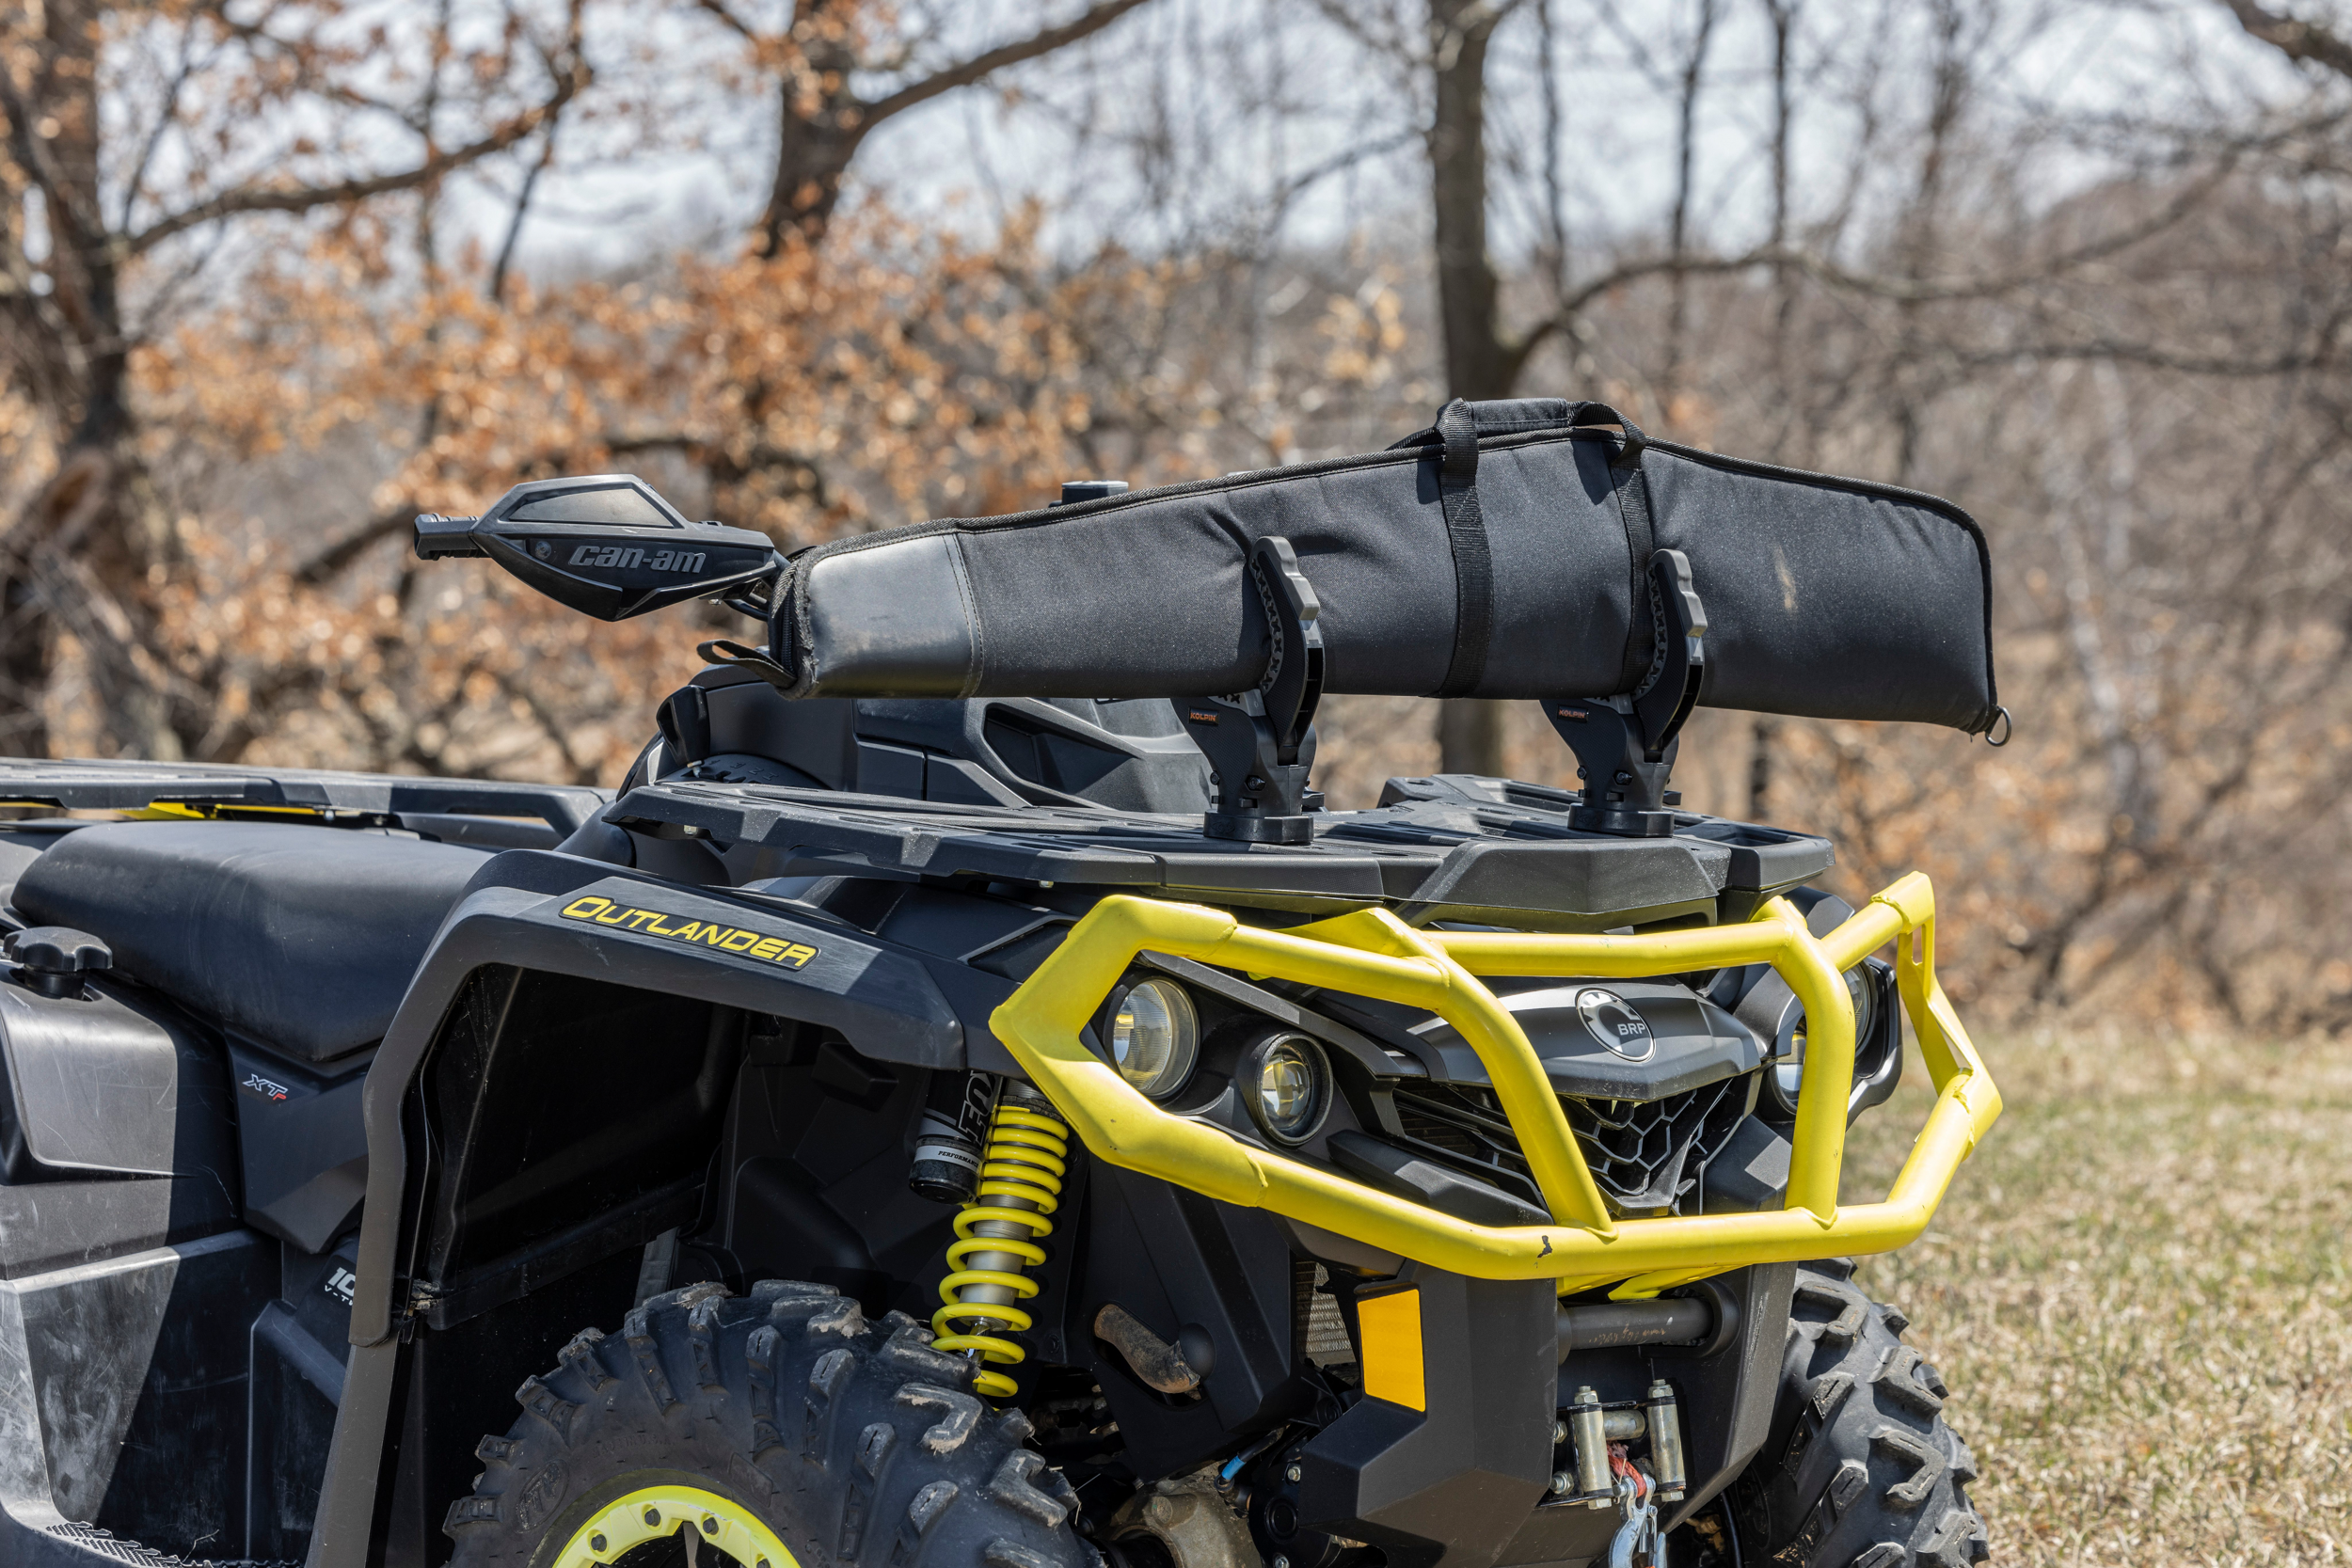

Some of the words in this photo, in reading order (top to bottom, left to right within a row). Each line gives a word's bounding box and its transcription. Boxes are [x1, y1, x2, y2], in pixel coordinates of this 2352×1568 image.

[569, 545, 707, 573] can-am
[1190, 712, 1216, 721] KOLPIN
[1559, 709, 1585, 719] KOLPIN
[1617, 1022, 1645, 1036] BRP
